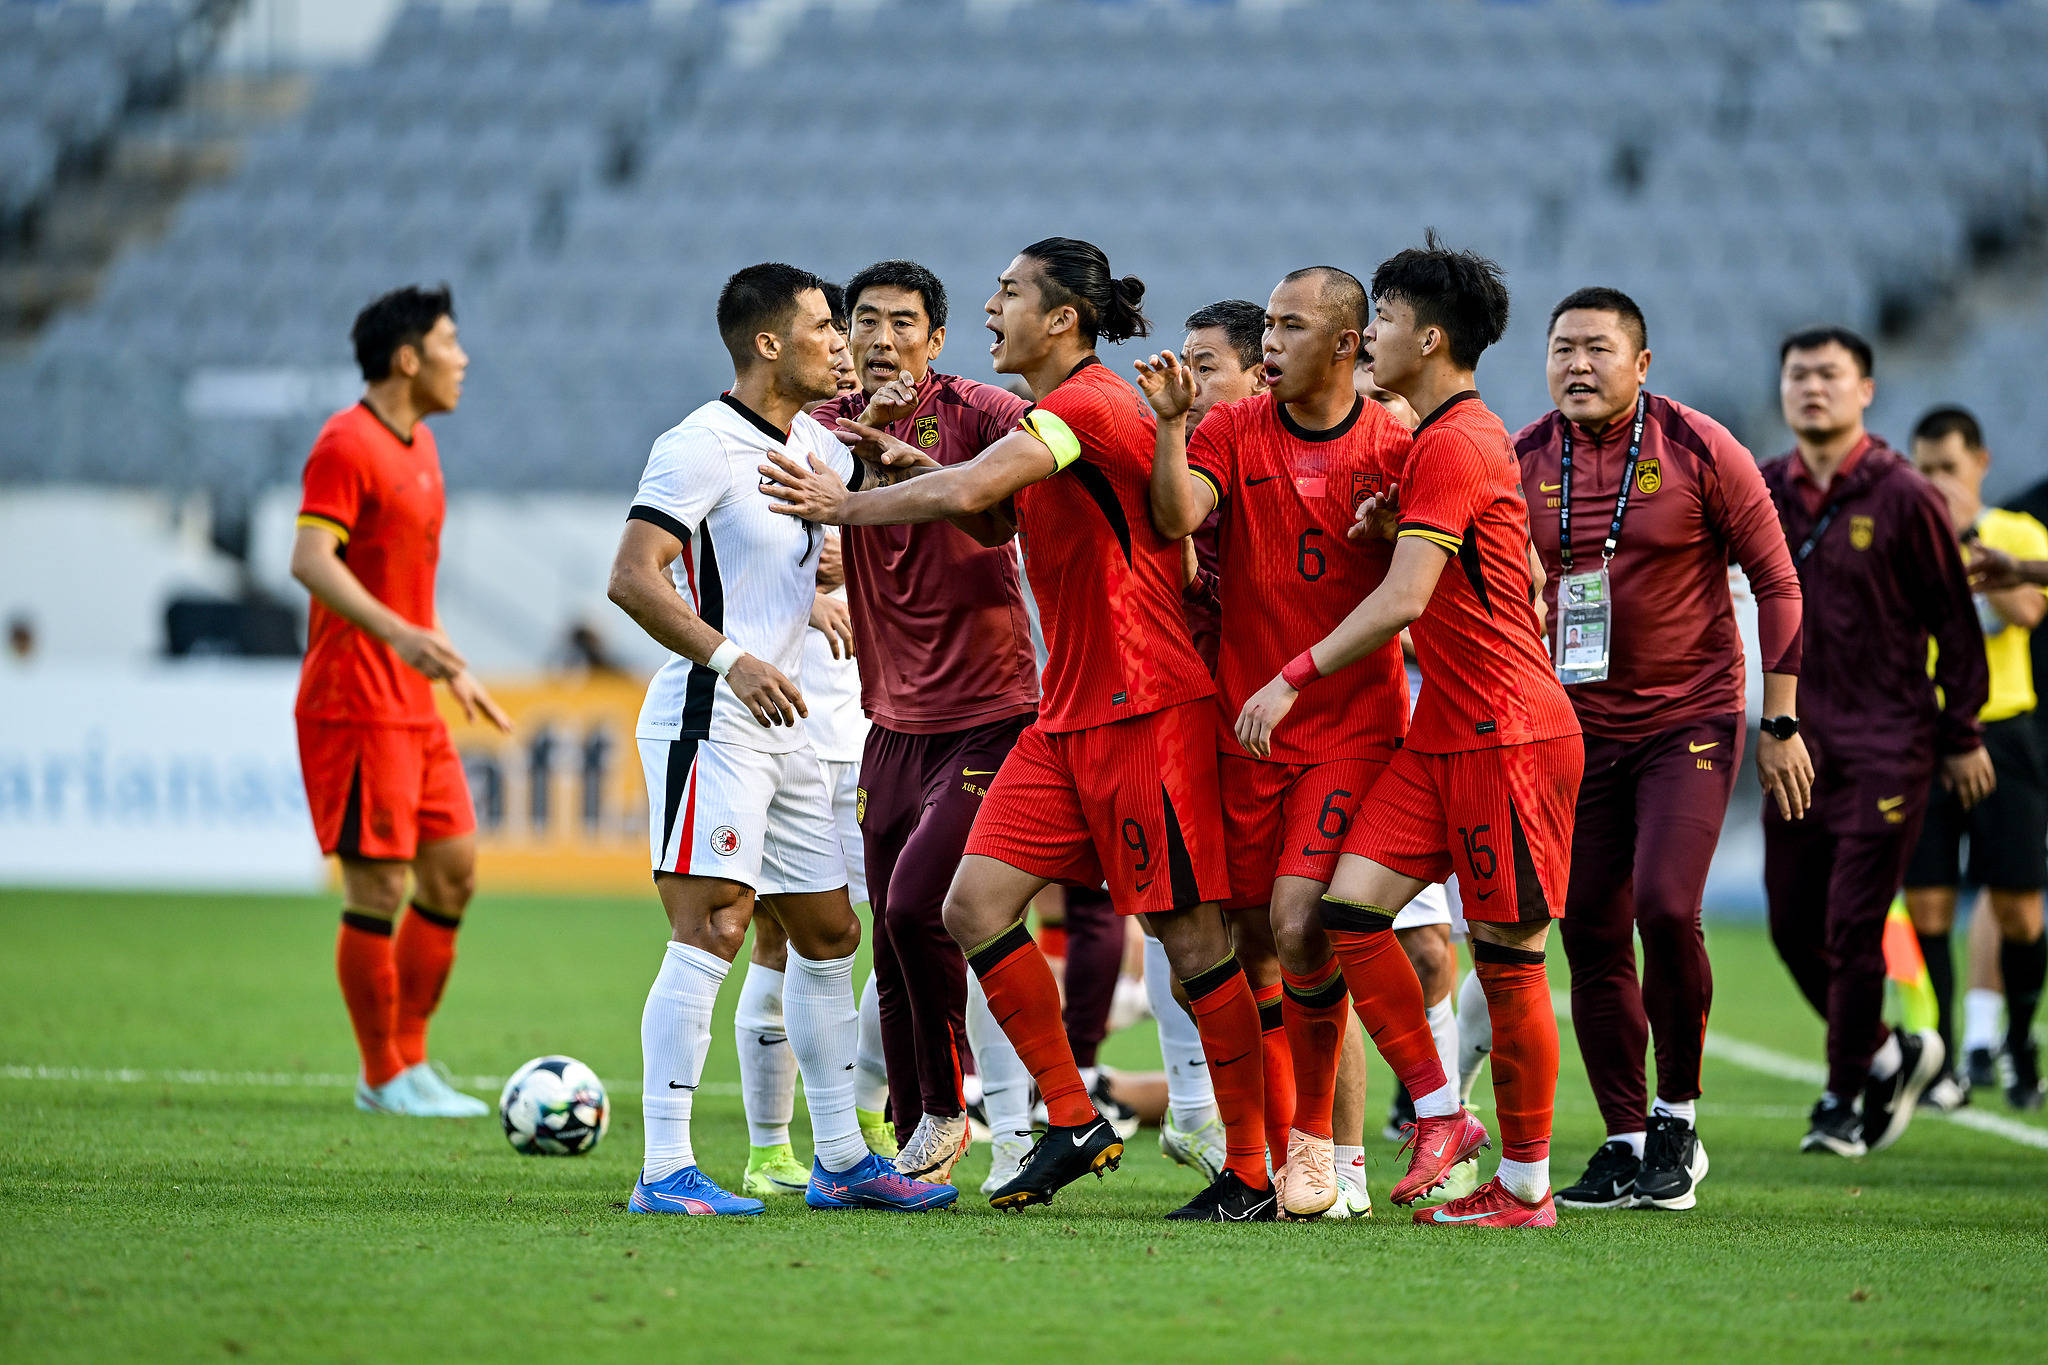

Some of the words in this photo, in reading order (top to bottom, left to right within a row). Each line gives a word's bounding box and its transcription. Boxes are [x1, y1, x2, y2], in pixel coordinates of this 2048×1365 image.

[1297, 527, 1326, 582] 6
[961, 781, 977, 794] XUE
[1317, 788, 1353, 840] 6
[1121, 817, 1150, 871] 9
[1457, 824, 1497, 881] 15
